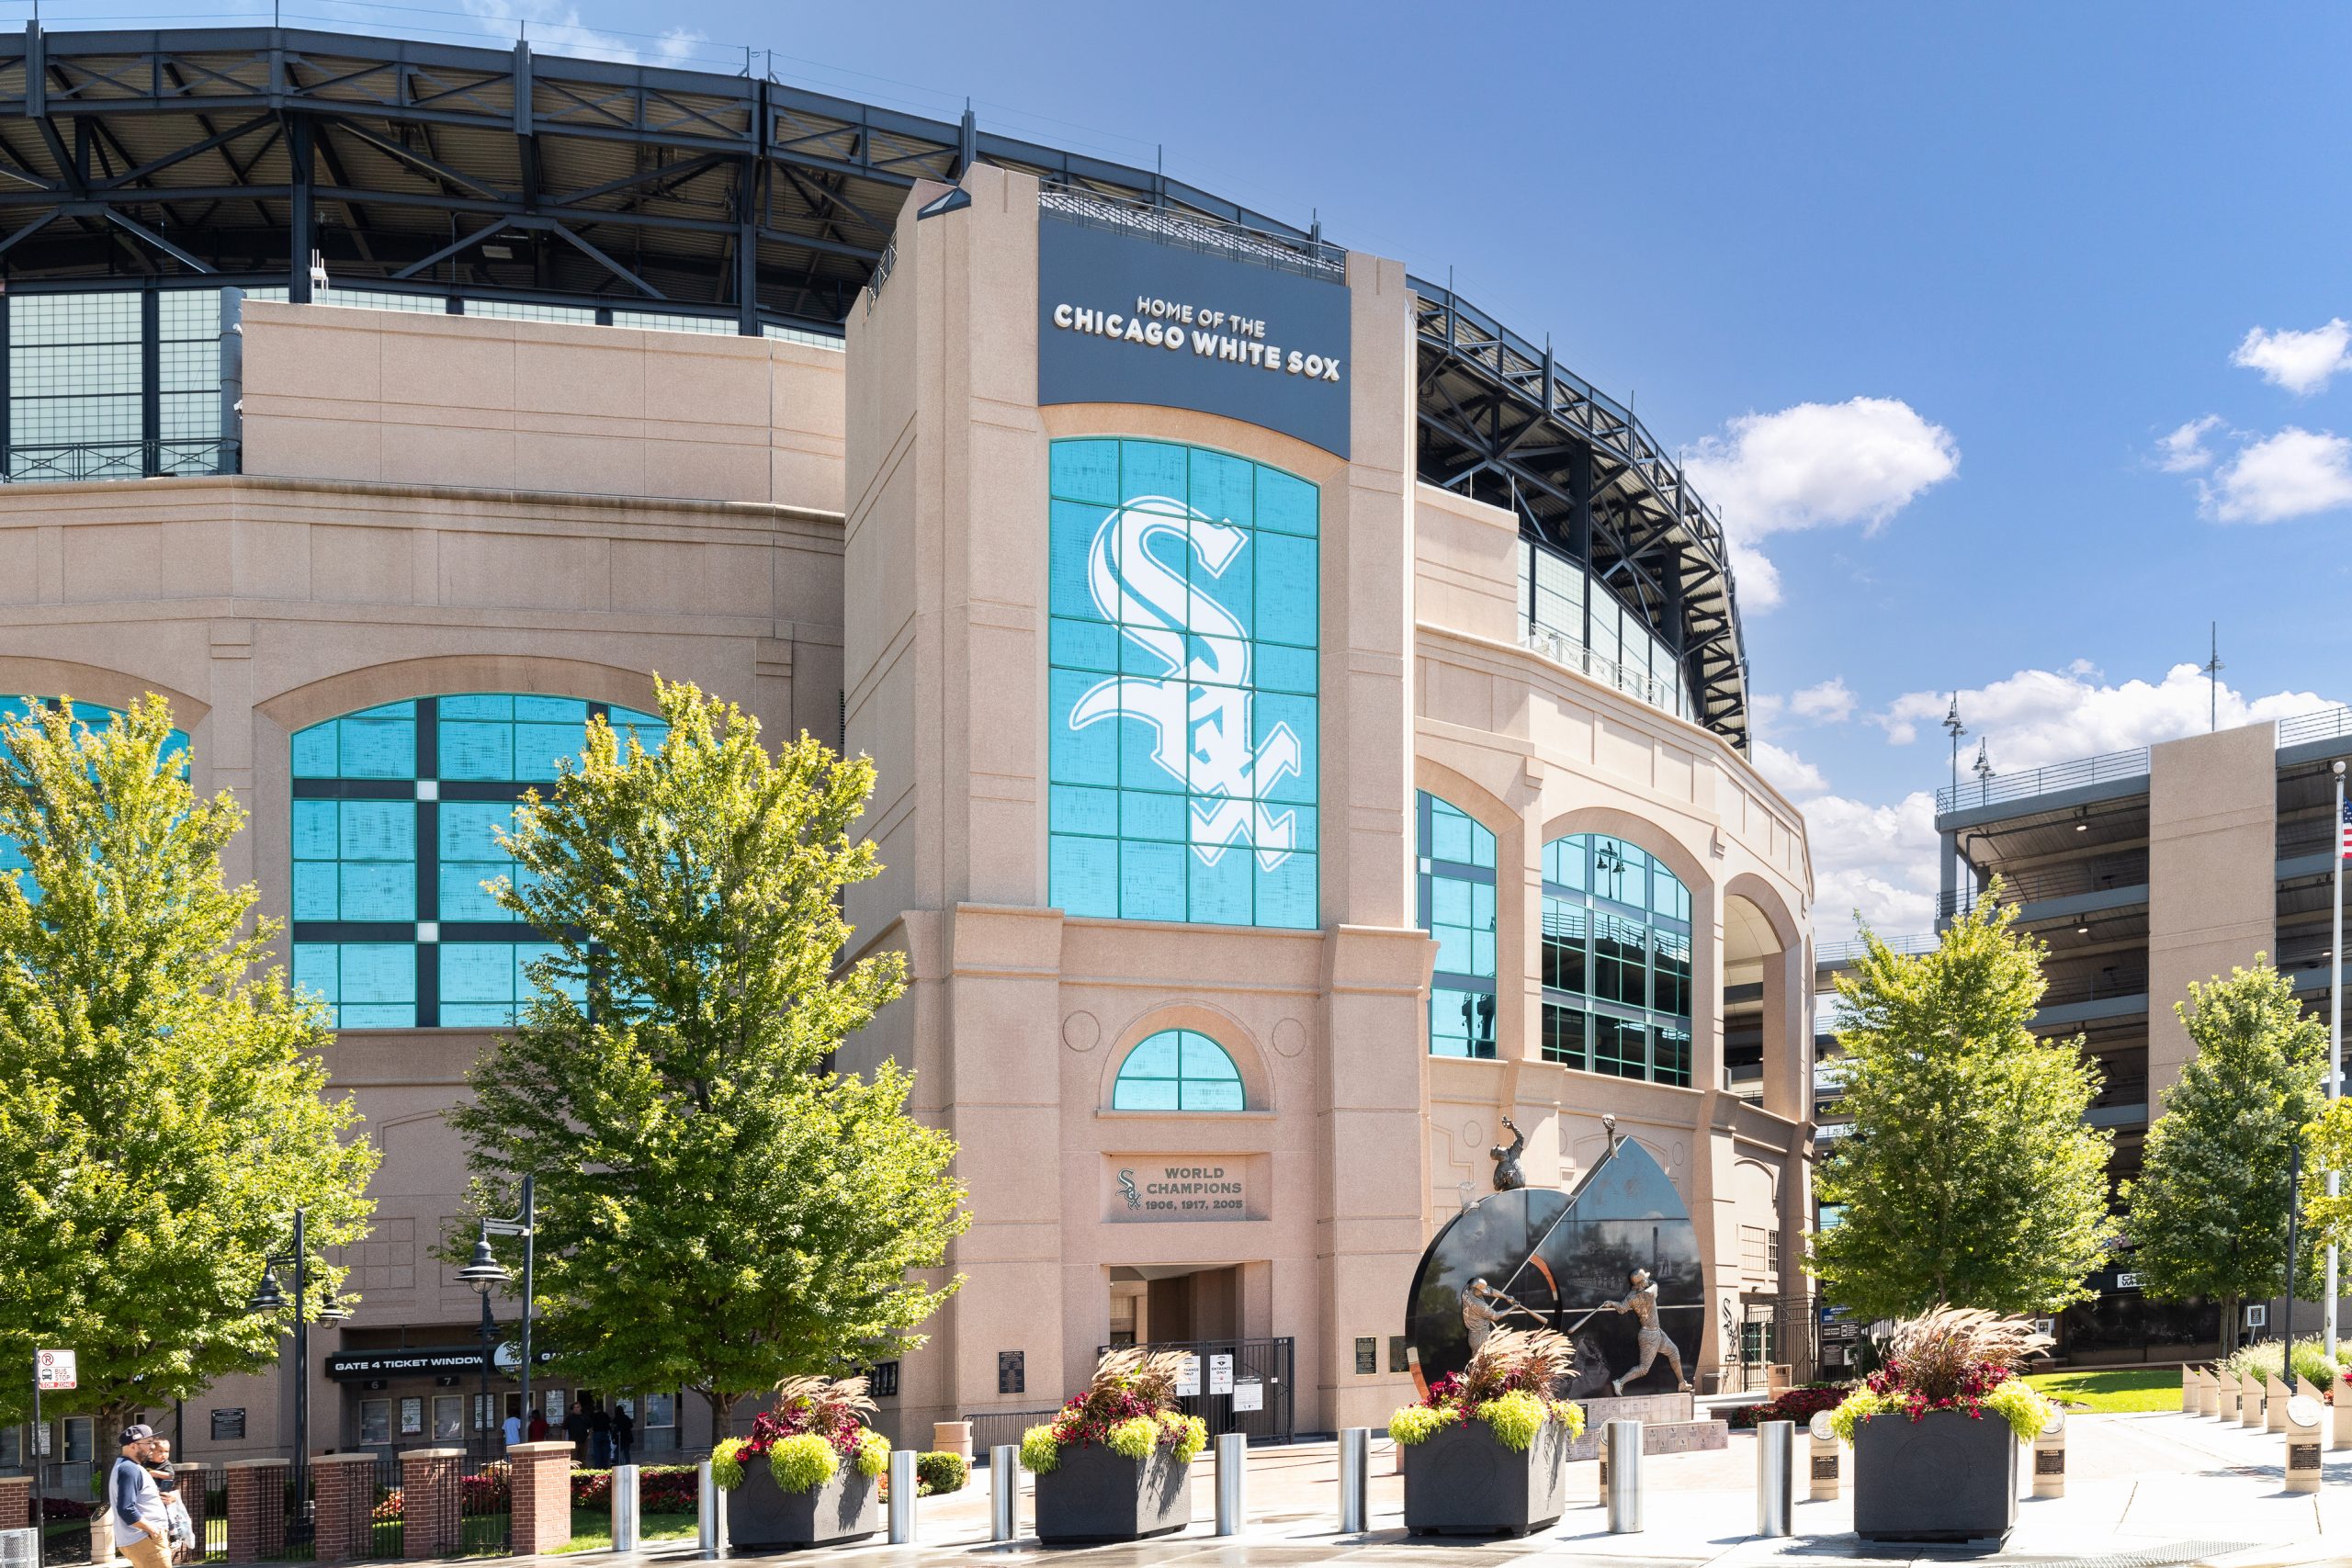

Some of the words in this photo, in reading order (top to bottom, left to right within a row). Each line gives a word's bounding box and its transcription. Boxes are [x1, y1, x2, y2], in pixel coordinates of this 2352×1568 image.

[1136, 295, 1193, 325] HOME
[1198, 308, 1225, 328] OF
[1229, 314, 1266, 339] THE
[1054, 303, 1185, 350] CHICAGO
[1192, 330, 1281, 369] WHITE
[1287, 350, 1340, 381] SOX
[1165, 1168, 1225, 1179] WORLD
[1147, 1183, 1242, 1194] CHAMPIONS
[1146, 1201, 1177, 1211] 1906,
[1182, 1200, 1209, 1211] 1917,
[1214, 1200, 1243, 1209] 2005
[334, 1362, 368, 1371] GATE
[383, 1359, 428, 1369] TICKET
[430, 1356, 483, 1366] WINDOW
[371, 1381, 379, 1389] 6
[444, 1377, 452, 1385] 7
